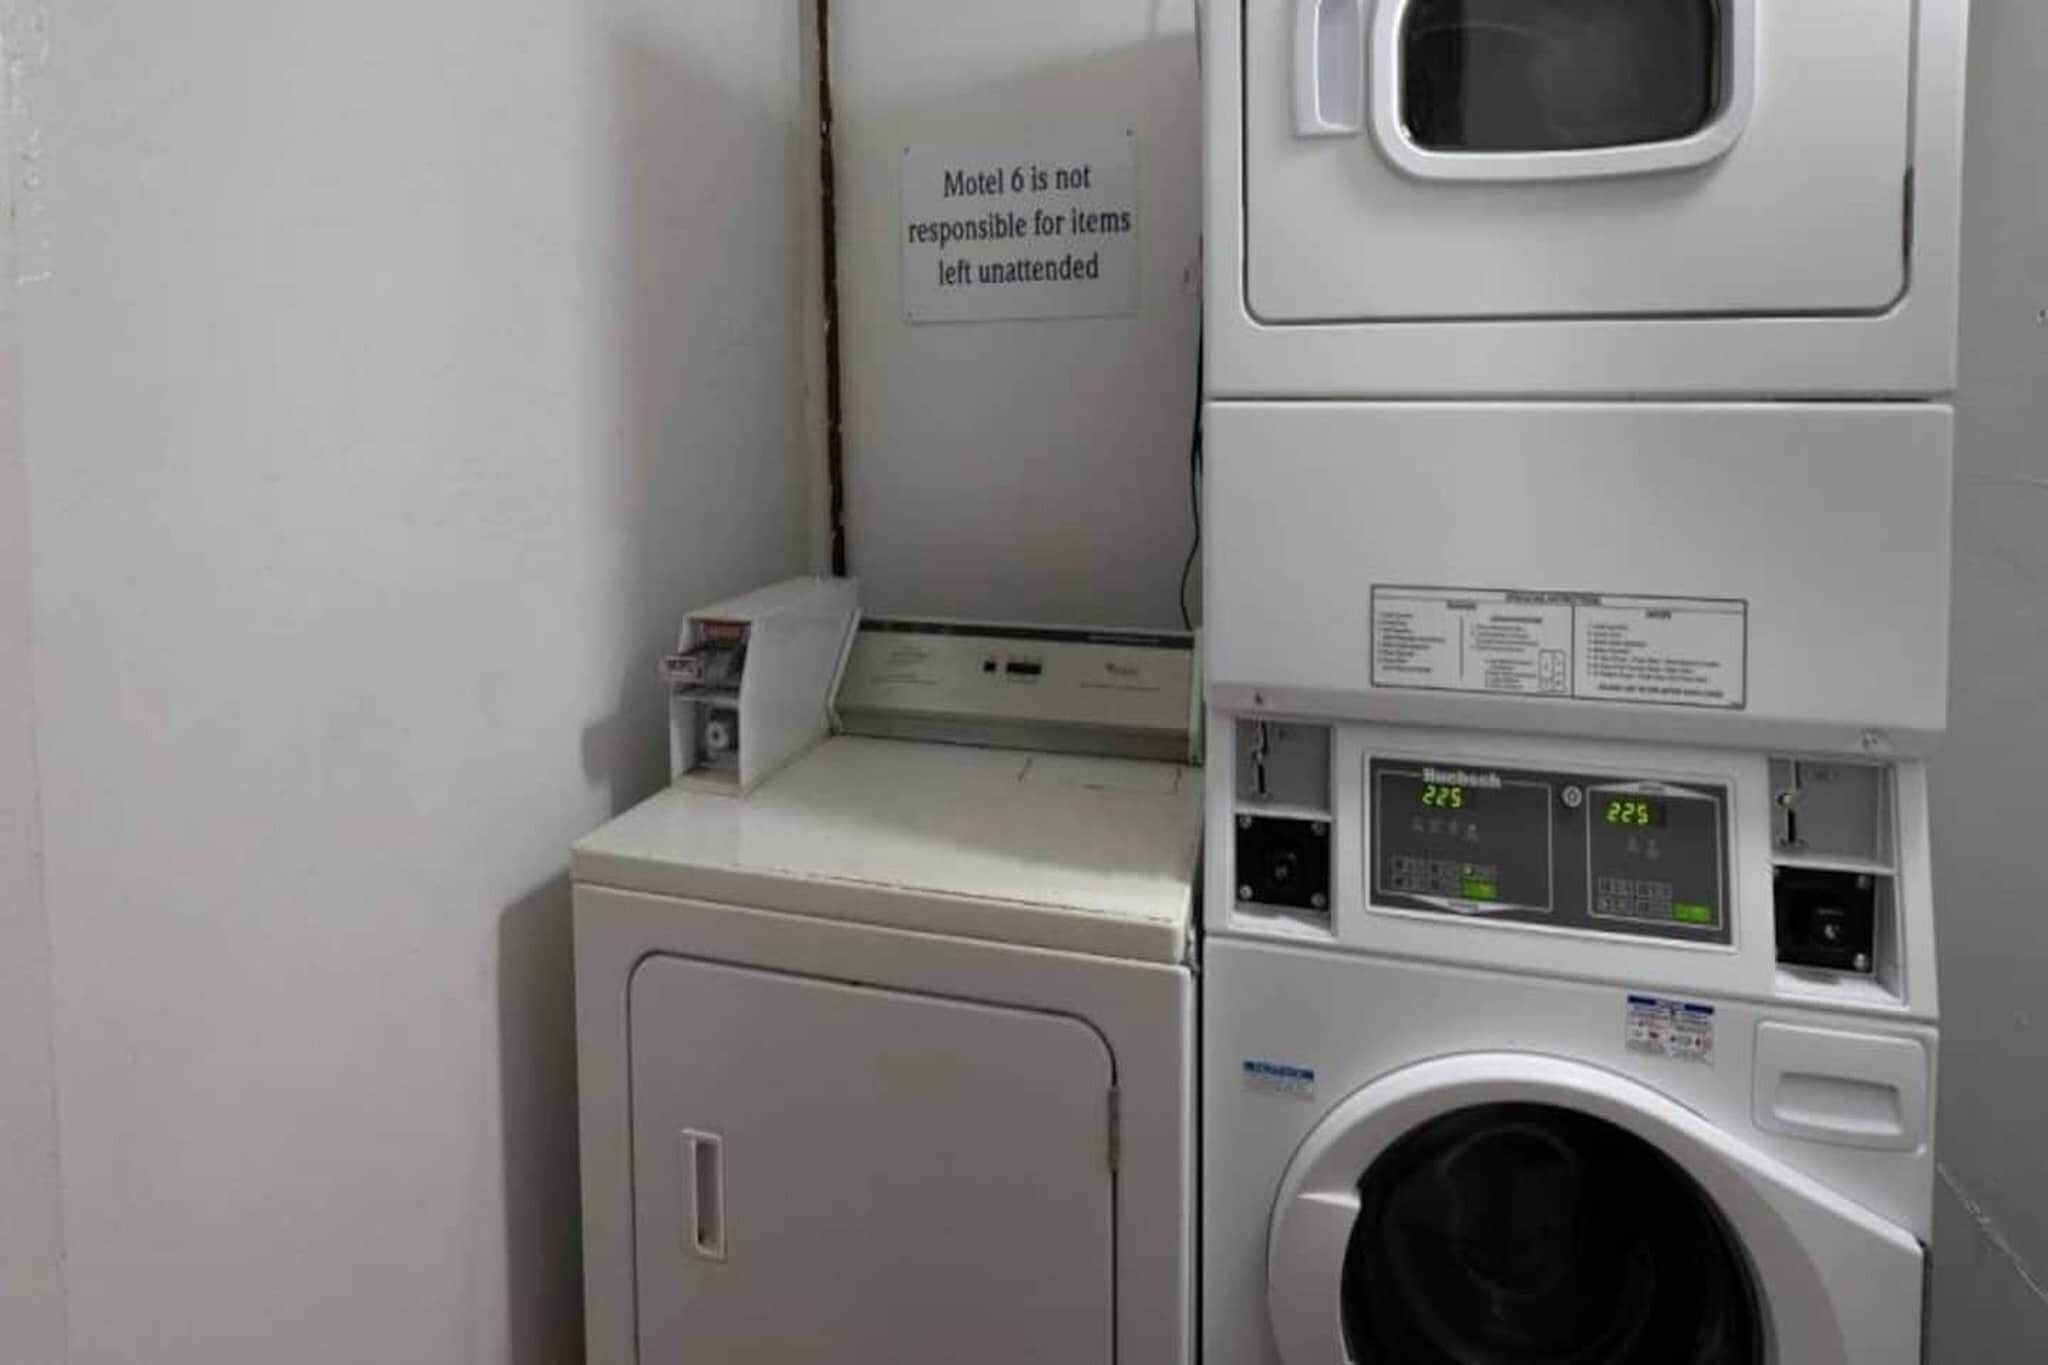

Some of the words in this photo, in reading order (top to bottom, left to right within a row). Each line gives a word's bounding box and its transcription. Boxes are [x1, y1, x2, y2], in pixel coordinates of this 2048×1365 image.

[943, 167, 1004, 198] Motel
[1010, 165, 1025, 193] 6
[1031, 165, 1048, 191] is
[1055, 165, 1091, 190] not
[908, 212, 1027, 248] responsible
[1034, 208, 1065, 236] for
[1071, 206, 1131, 235] items
[938, 258, 972, 286] left
[978, 250, 1100, 284] unattended
[1421, 784, 1462, 808] 225
[1607, 801, 1649, 826] 225
